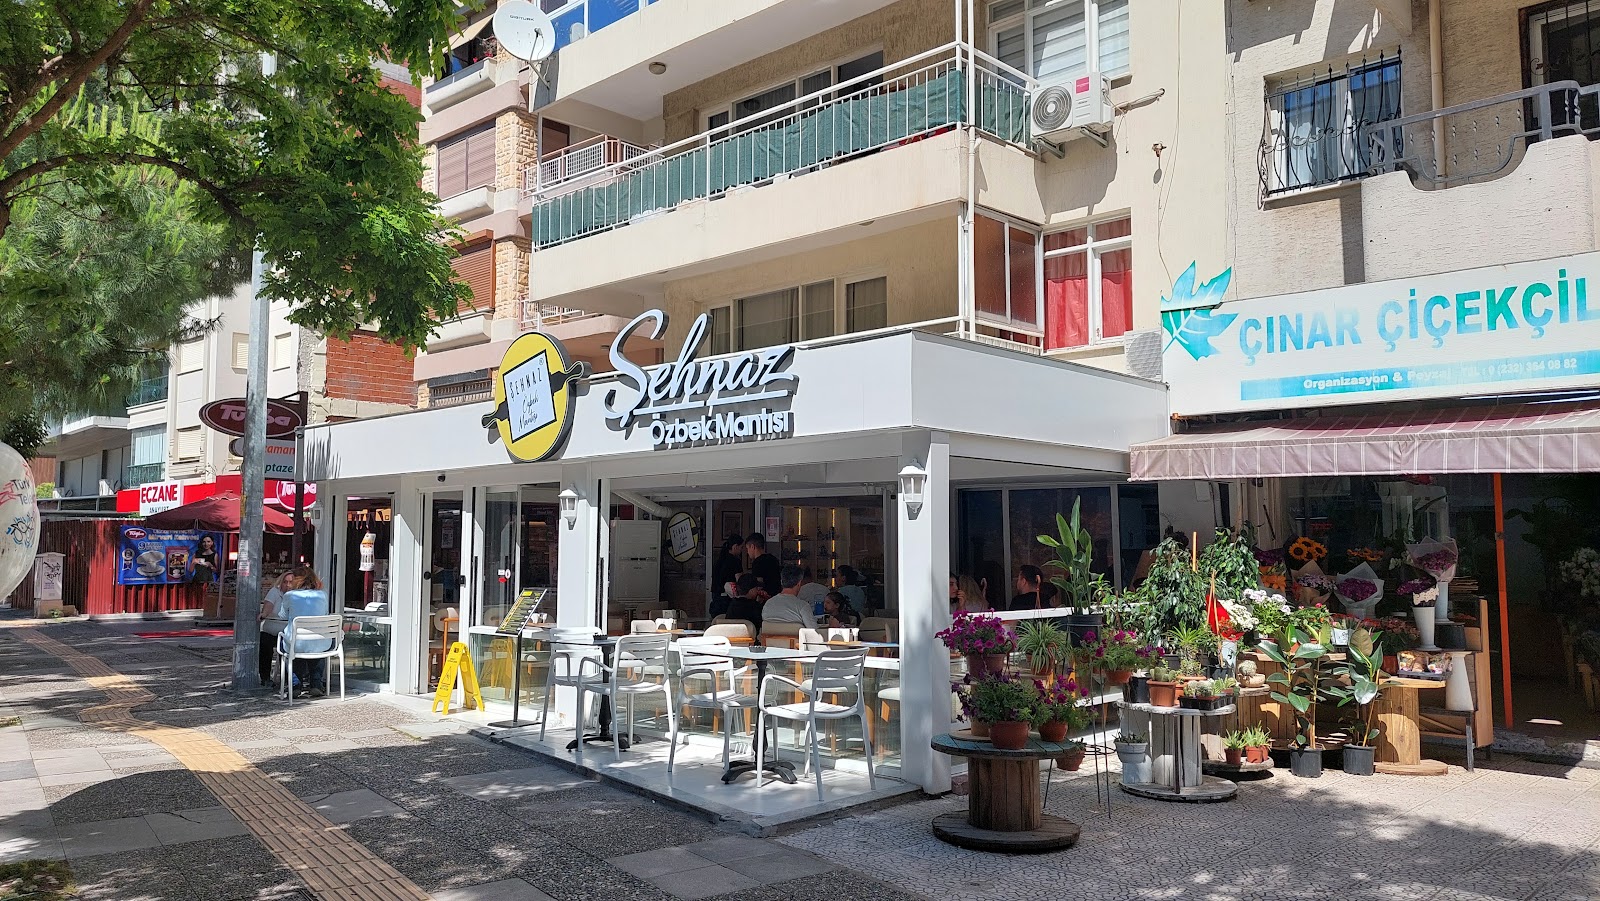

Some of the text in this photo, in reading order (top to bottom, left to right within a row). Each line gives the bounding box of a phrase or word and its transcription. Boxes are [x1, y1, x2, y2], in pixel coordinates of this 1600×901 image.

[1239, 307, 1362, 366] ÇINAR
[604, 308, 796, 428] Şehnaz
[1303, 373, 1389, 390] Organizasyon
[1392, 371, 1403, 382] &
[650, 407, 790, 445] Özbek Mantısı
[265, 445, 296, 455] aman
[264, 463, 294, 474] ptaze
[141, 484, 178, 504] ECZANE
